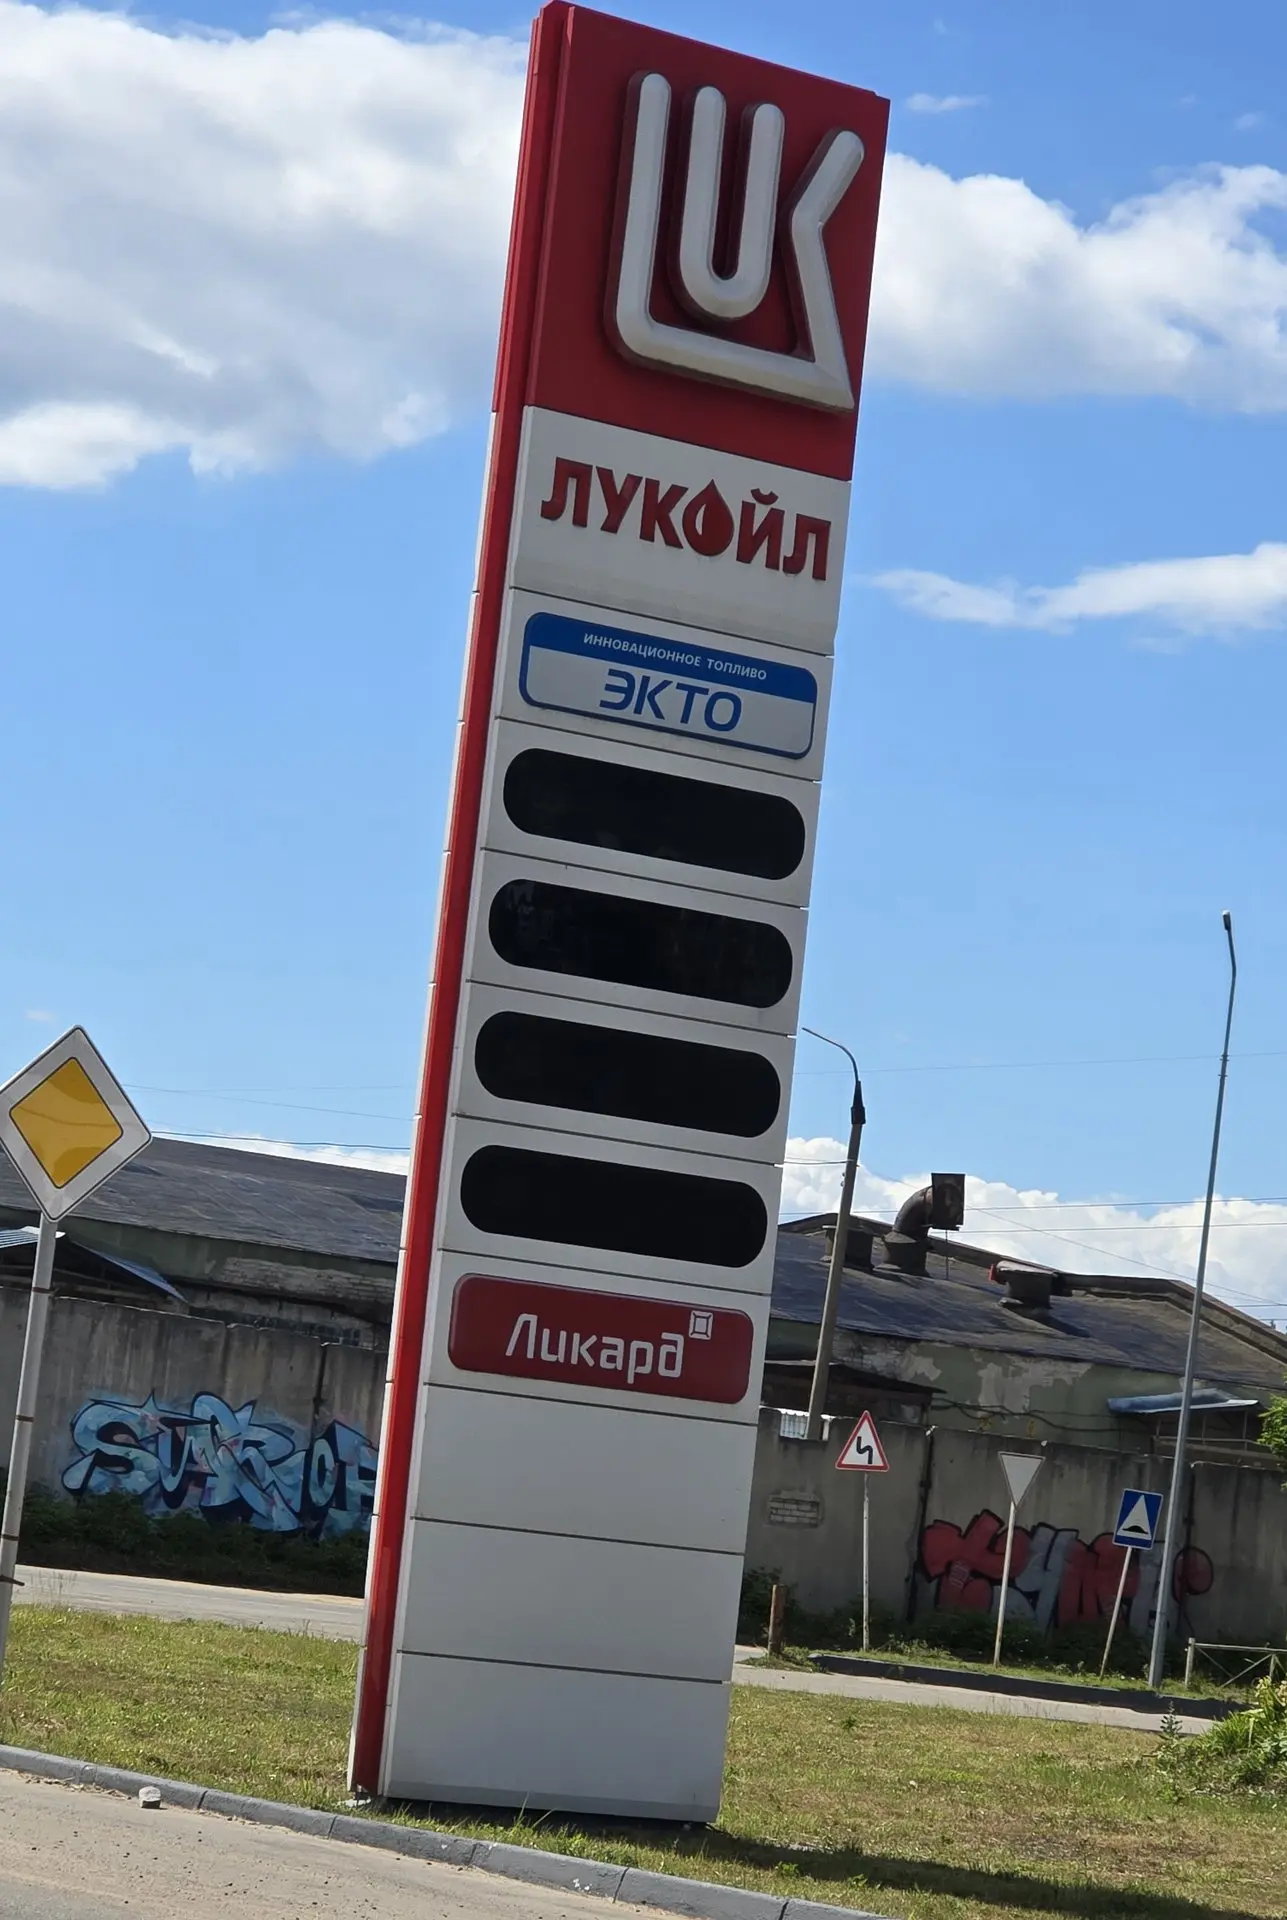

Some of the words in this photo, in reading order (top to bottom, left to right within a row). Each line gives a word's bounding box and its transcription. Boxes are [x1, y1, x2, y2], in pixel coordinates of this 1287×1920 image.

[540, 457, 832, 581] ЛУКОЙЛ
[583, 633, 702, 667] ИННОВАЦИОННОЕ
[706, 658, 767, 681] ТОПЛИВО
[599, 668, 742, 732] ЭКТО
[505, 1313, 685, 1384] Ликард
